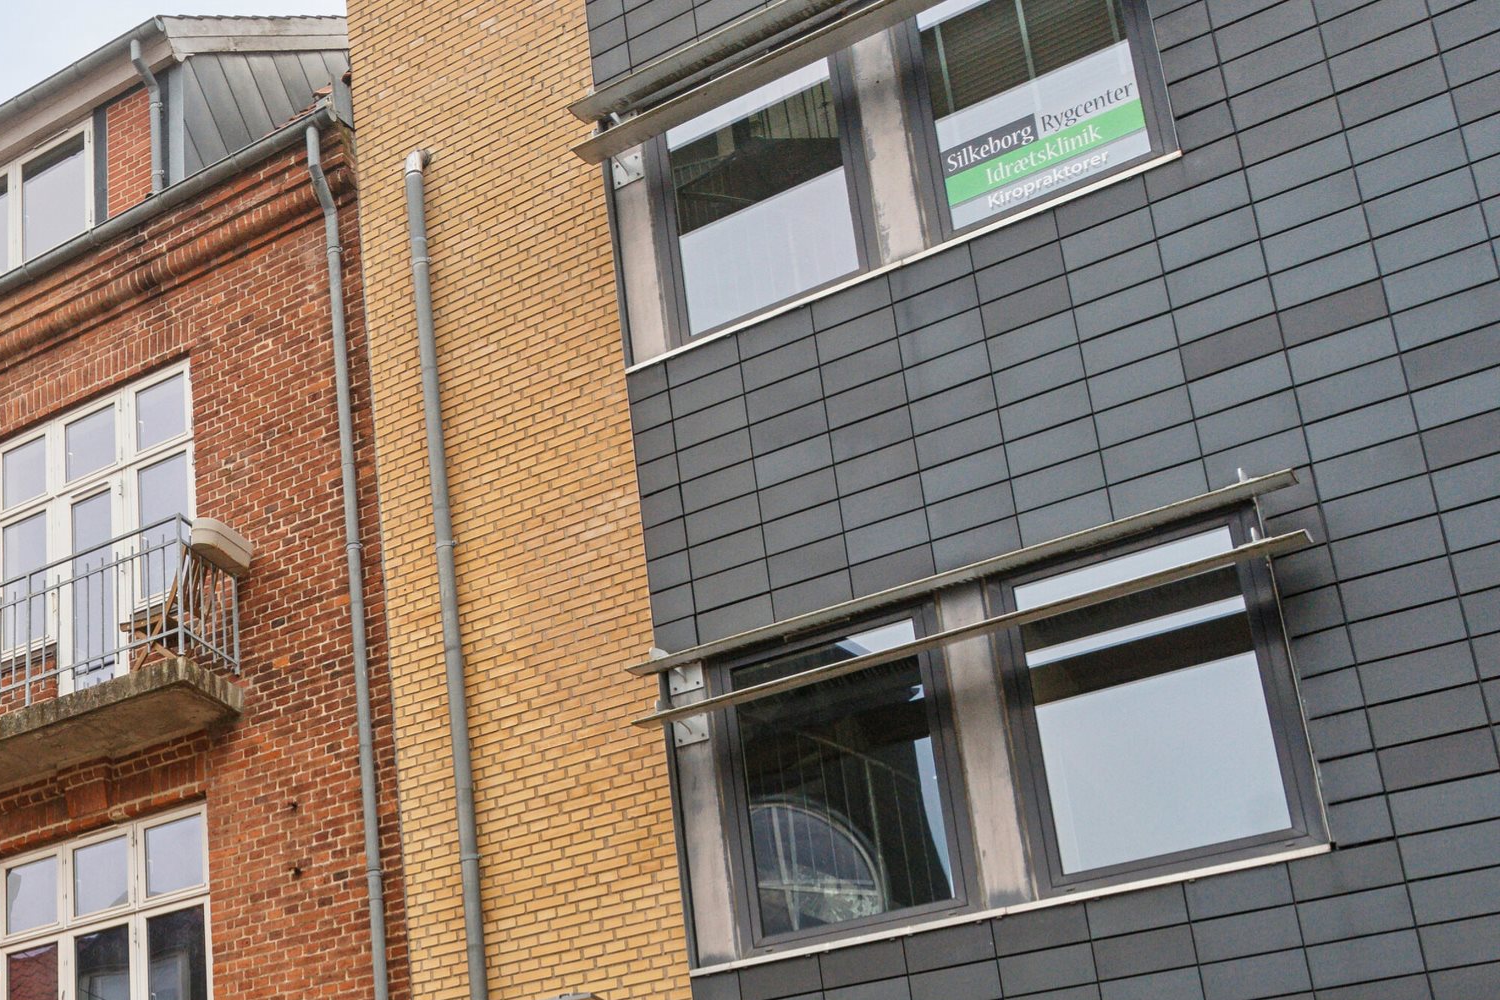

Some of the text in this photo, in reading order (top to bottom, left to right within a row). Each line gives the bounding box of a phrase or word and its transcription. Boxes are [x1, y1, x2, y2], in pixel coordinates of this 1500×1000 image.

[947, 82, 1133, 172] Silkeborg Rygcenter
[986, 124, 1103, 185] Idrætsklinik
[987, 150, 1109, 209] Kiropraktorer
